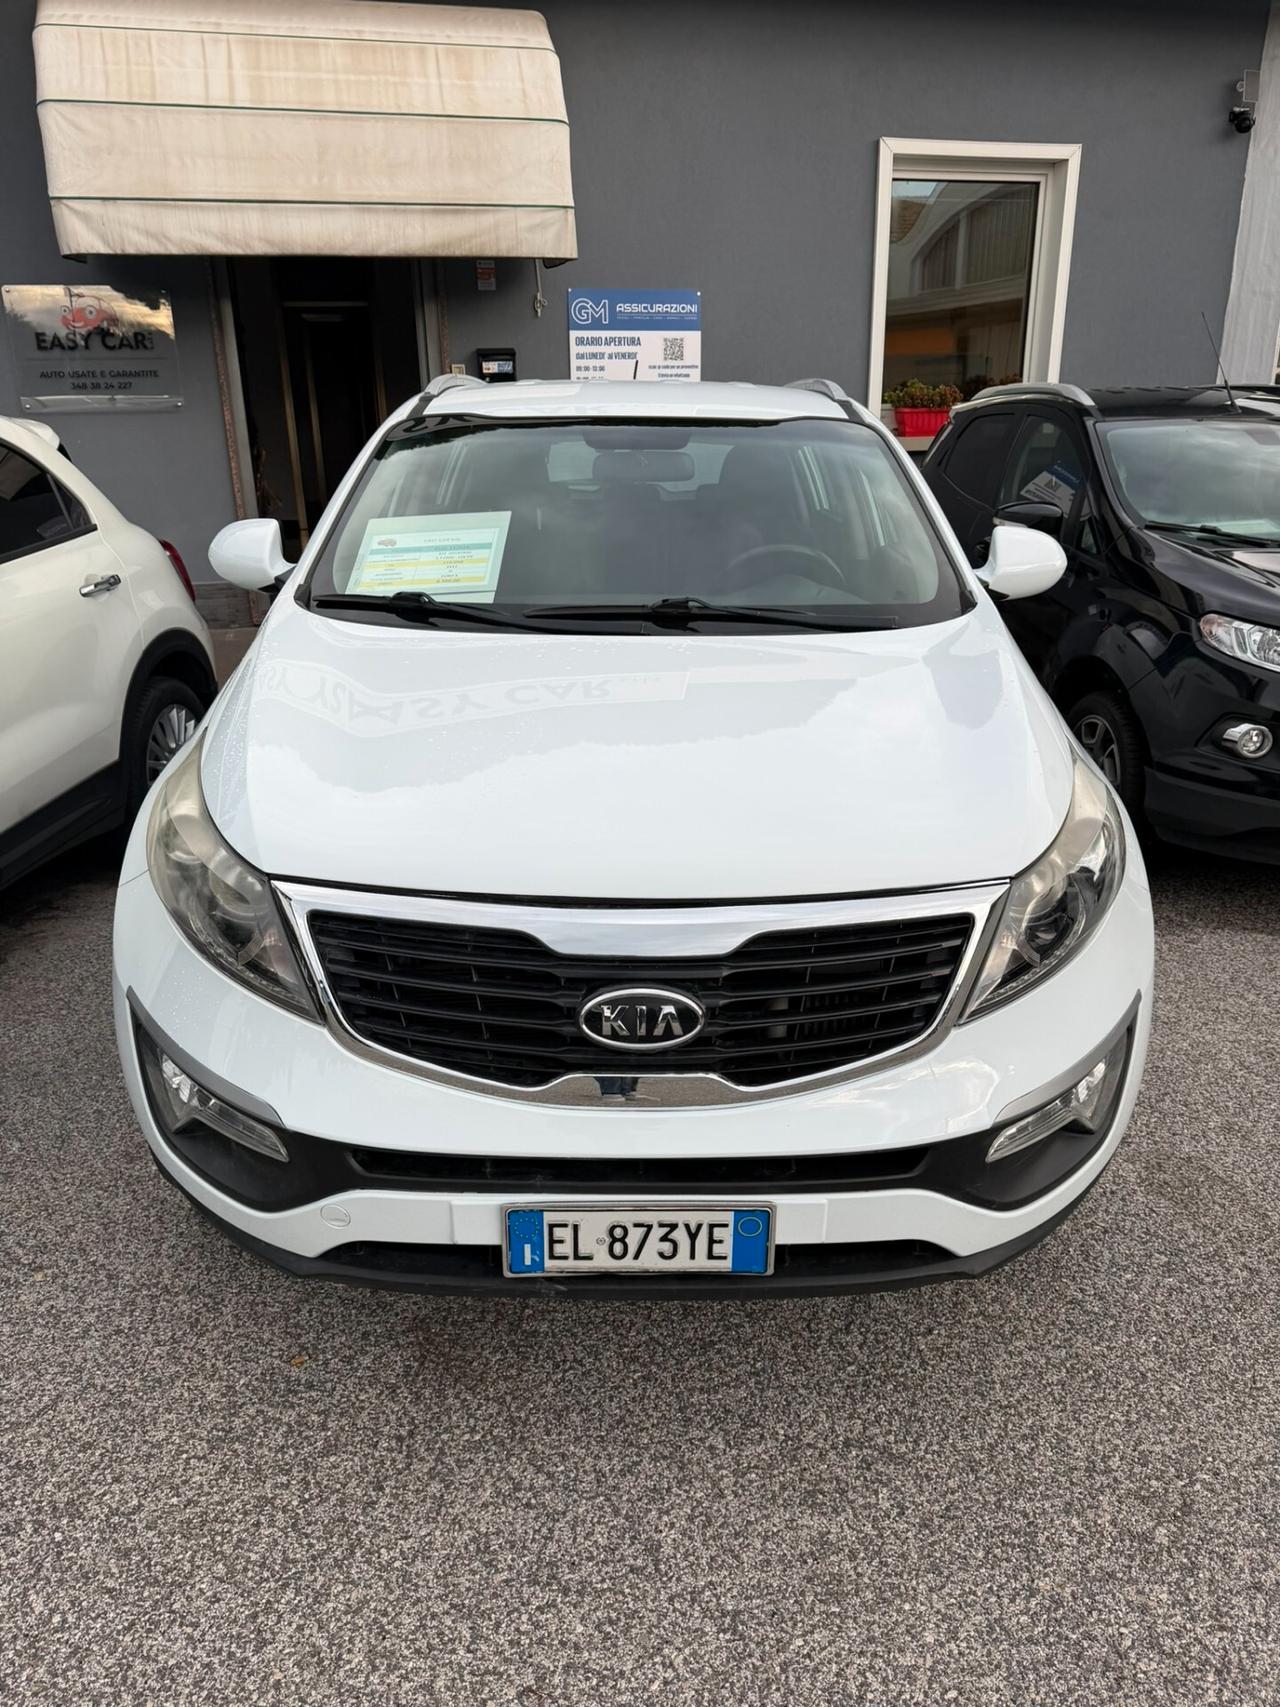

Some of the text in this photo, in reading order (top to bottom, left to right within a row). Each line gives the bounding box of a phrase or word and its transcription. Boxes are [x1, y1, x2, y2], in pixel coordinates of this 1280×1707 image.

[571, 298, 609, 325] GM
[616, 303, 698, 313] ASSICURAZIONI
[34, 332, 93, 350] EASY
[101, 331, 148, 350] CAR
[575, 336, 642, 348] ORARIO APERTURA
[576, 351, 585, 360] dal
[607, 352, 614, 360] al
[39, 369, 160, 379] AUTO USATE E GARANTITE
[104, 382, 115, 390] 24
[117, 381, 133, 389] 227
[601, 1005, 684, 1036] KIA
[547, 1222, 594, 1262] EL
[607, 1222, 730, 1262] 873YE
